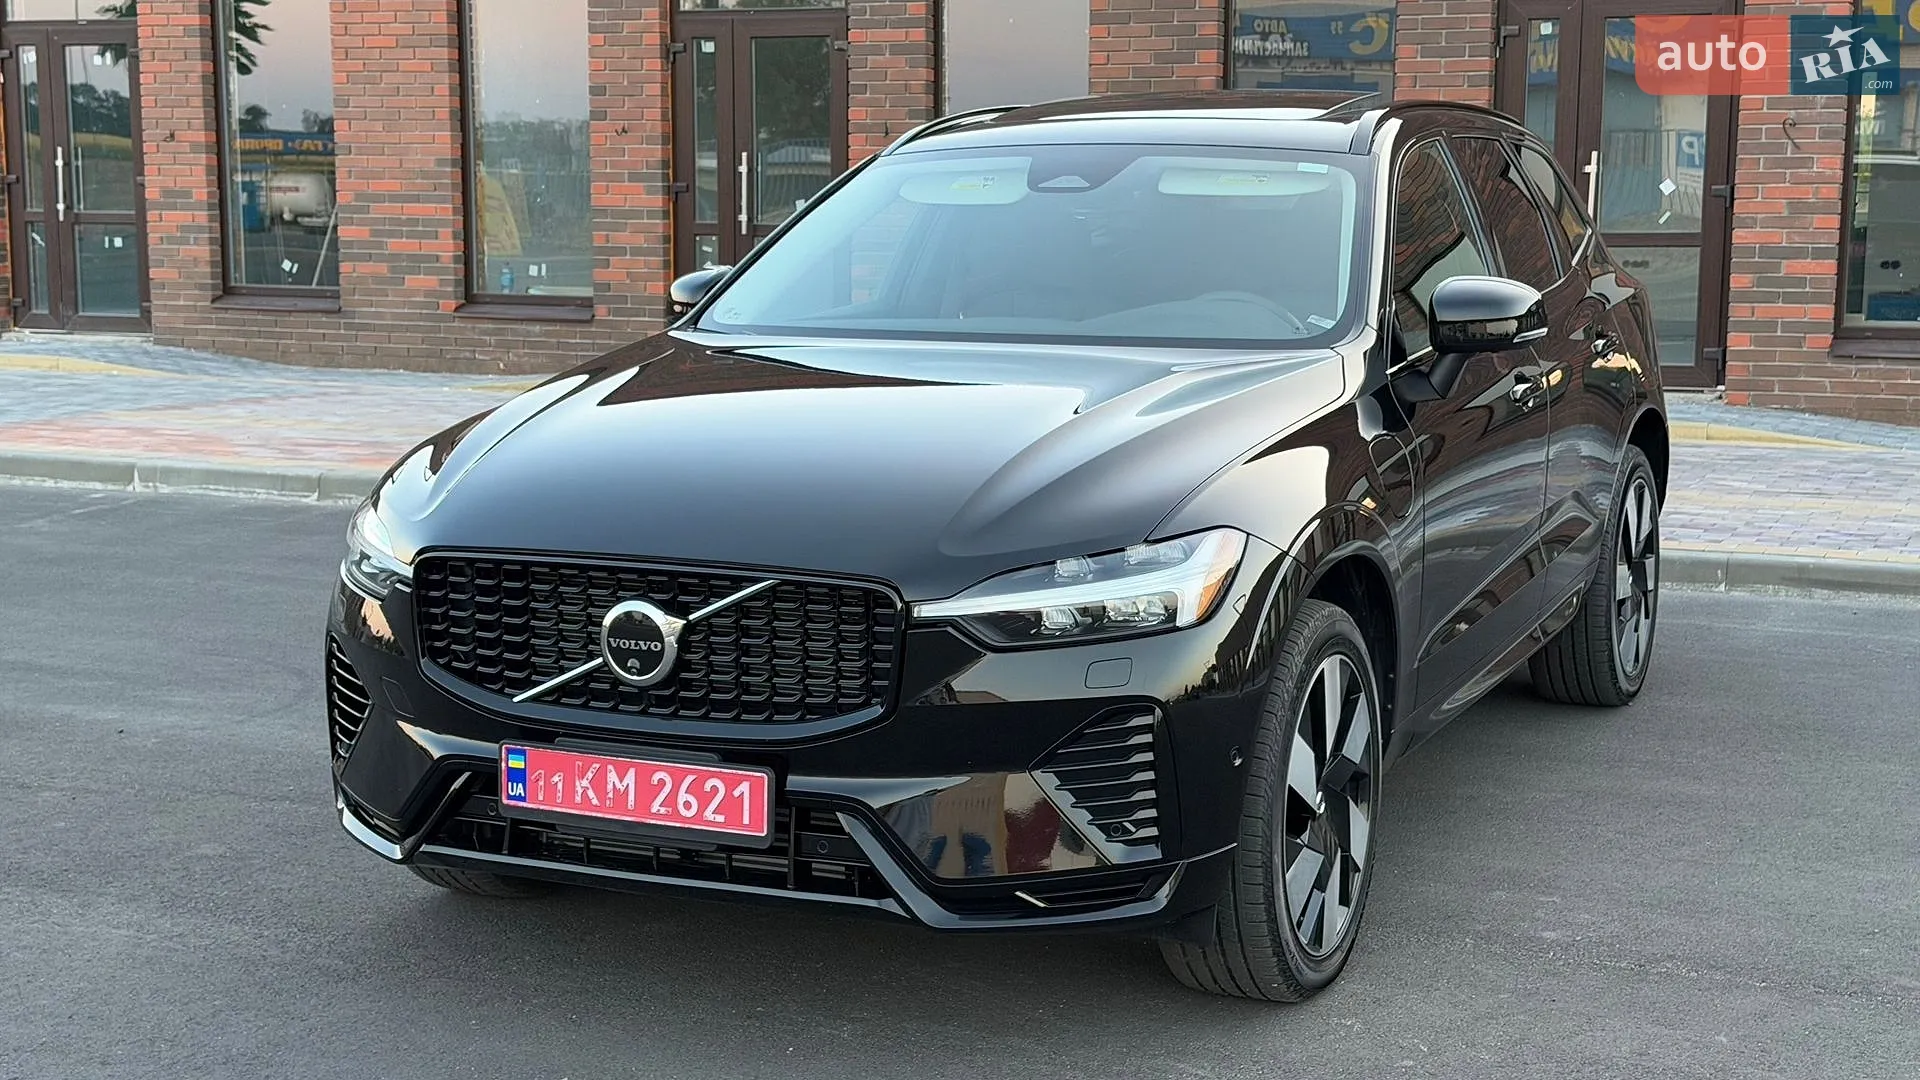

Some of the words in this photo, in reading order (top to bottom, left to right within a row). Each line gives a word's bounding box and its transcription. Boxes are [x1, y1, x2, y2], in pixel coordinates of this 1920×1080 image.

[608, 637, 662, 651] VOLVO
[507, 782, 525, 797] UA
[650, 771, 751, 825] 2621
